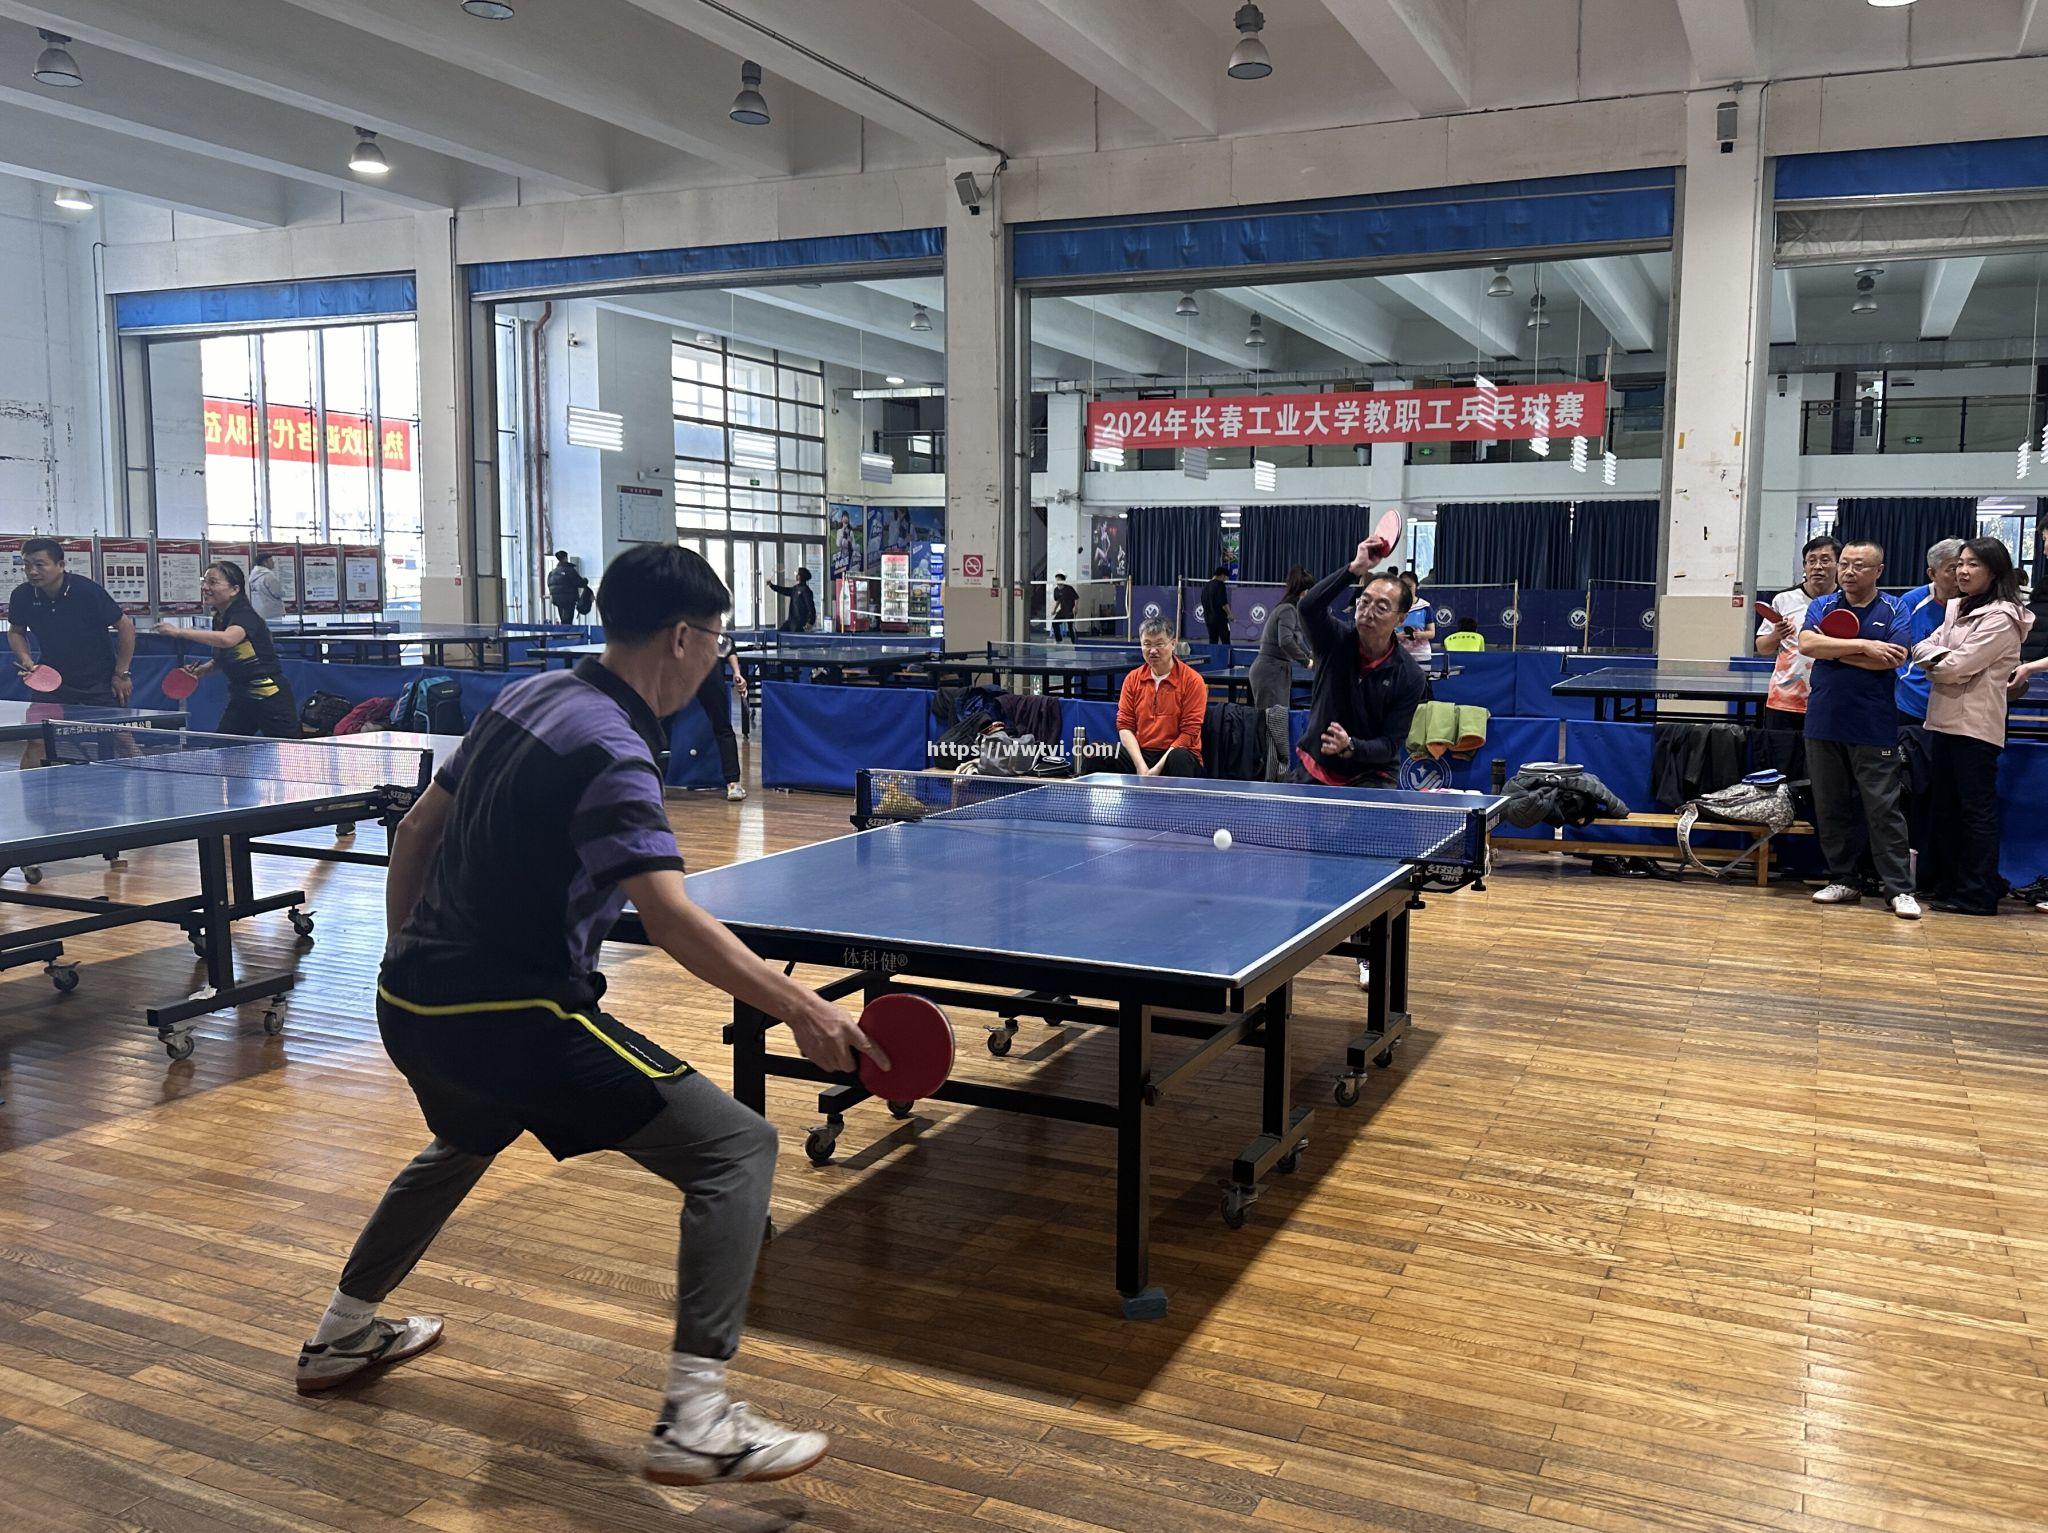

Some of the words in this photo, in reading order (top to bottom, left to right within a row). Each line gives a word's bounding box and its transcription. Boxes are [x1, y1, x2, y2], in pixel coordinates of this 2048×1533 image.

[1102, 391, 1585, 441] 2024年长春工业大学教职工乒乓球赛
